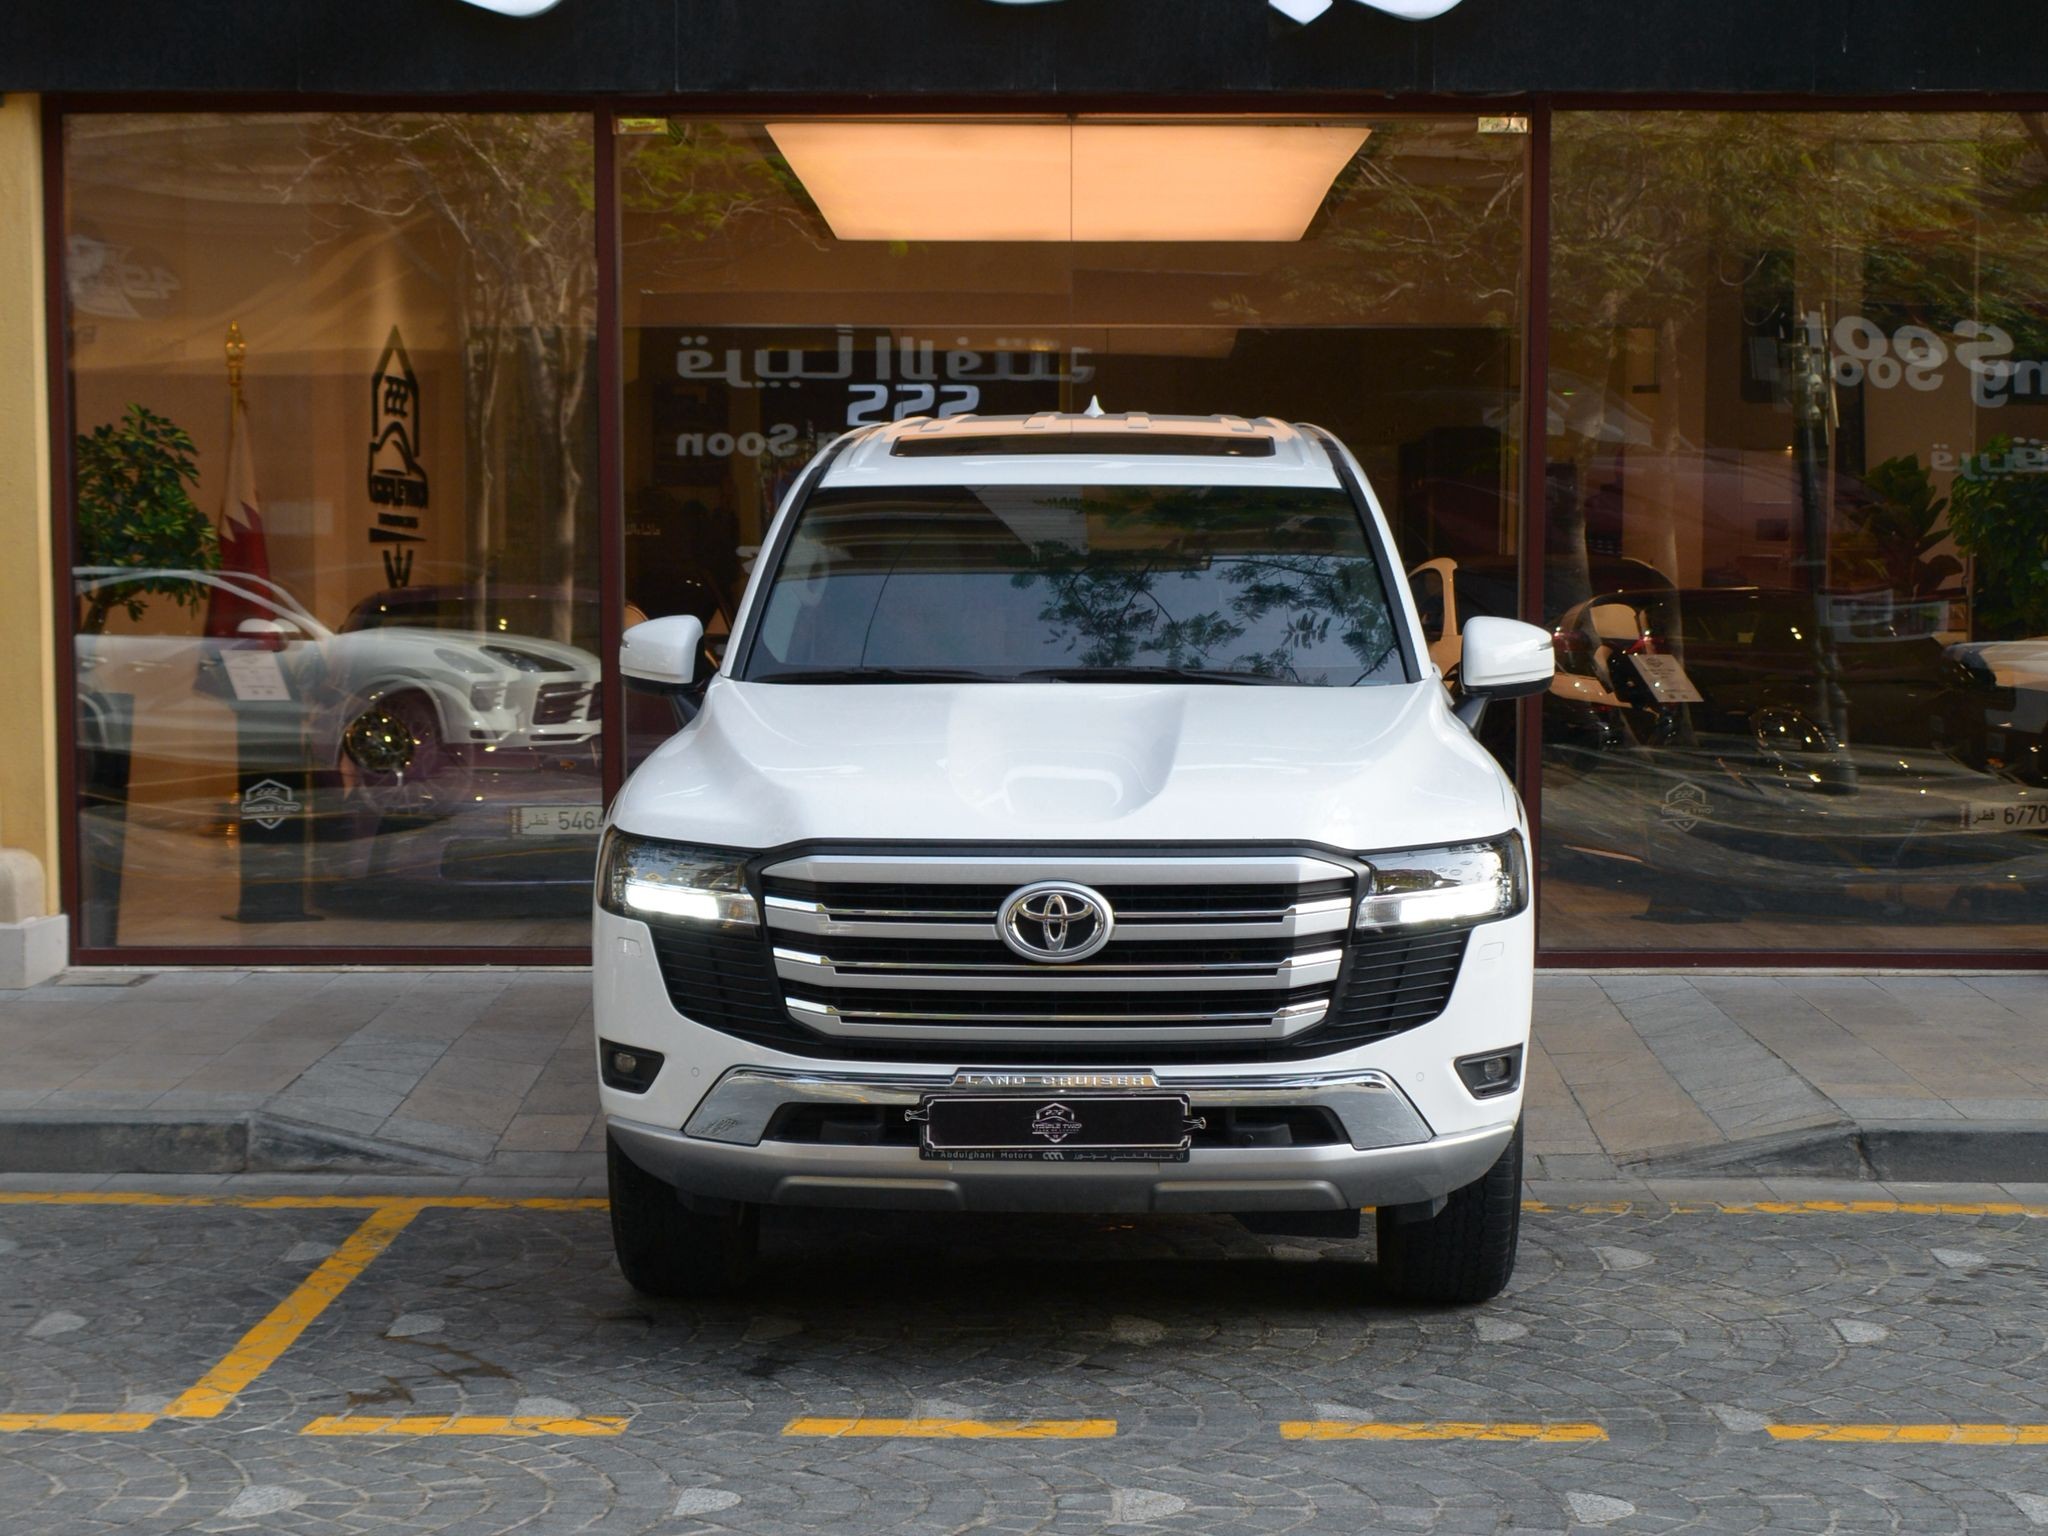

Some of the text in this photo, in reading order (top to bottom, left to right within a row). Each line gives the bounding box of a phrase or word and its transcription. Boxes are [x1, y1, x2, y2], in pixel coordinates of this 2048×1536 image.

[967, 1075, 1146, 1086] LAND CRUISER
[940, 1151, 995, 1160] Abdulghani
[1000, 1151, 1033, 1159] Motors
